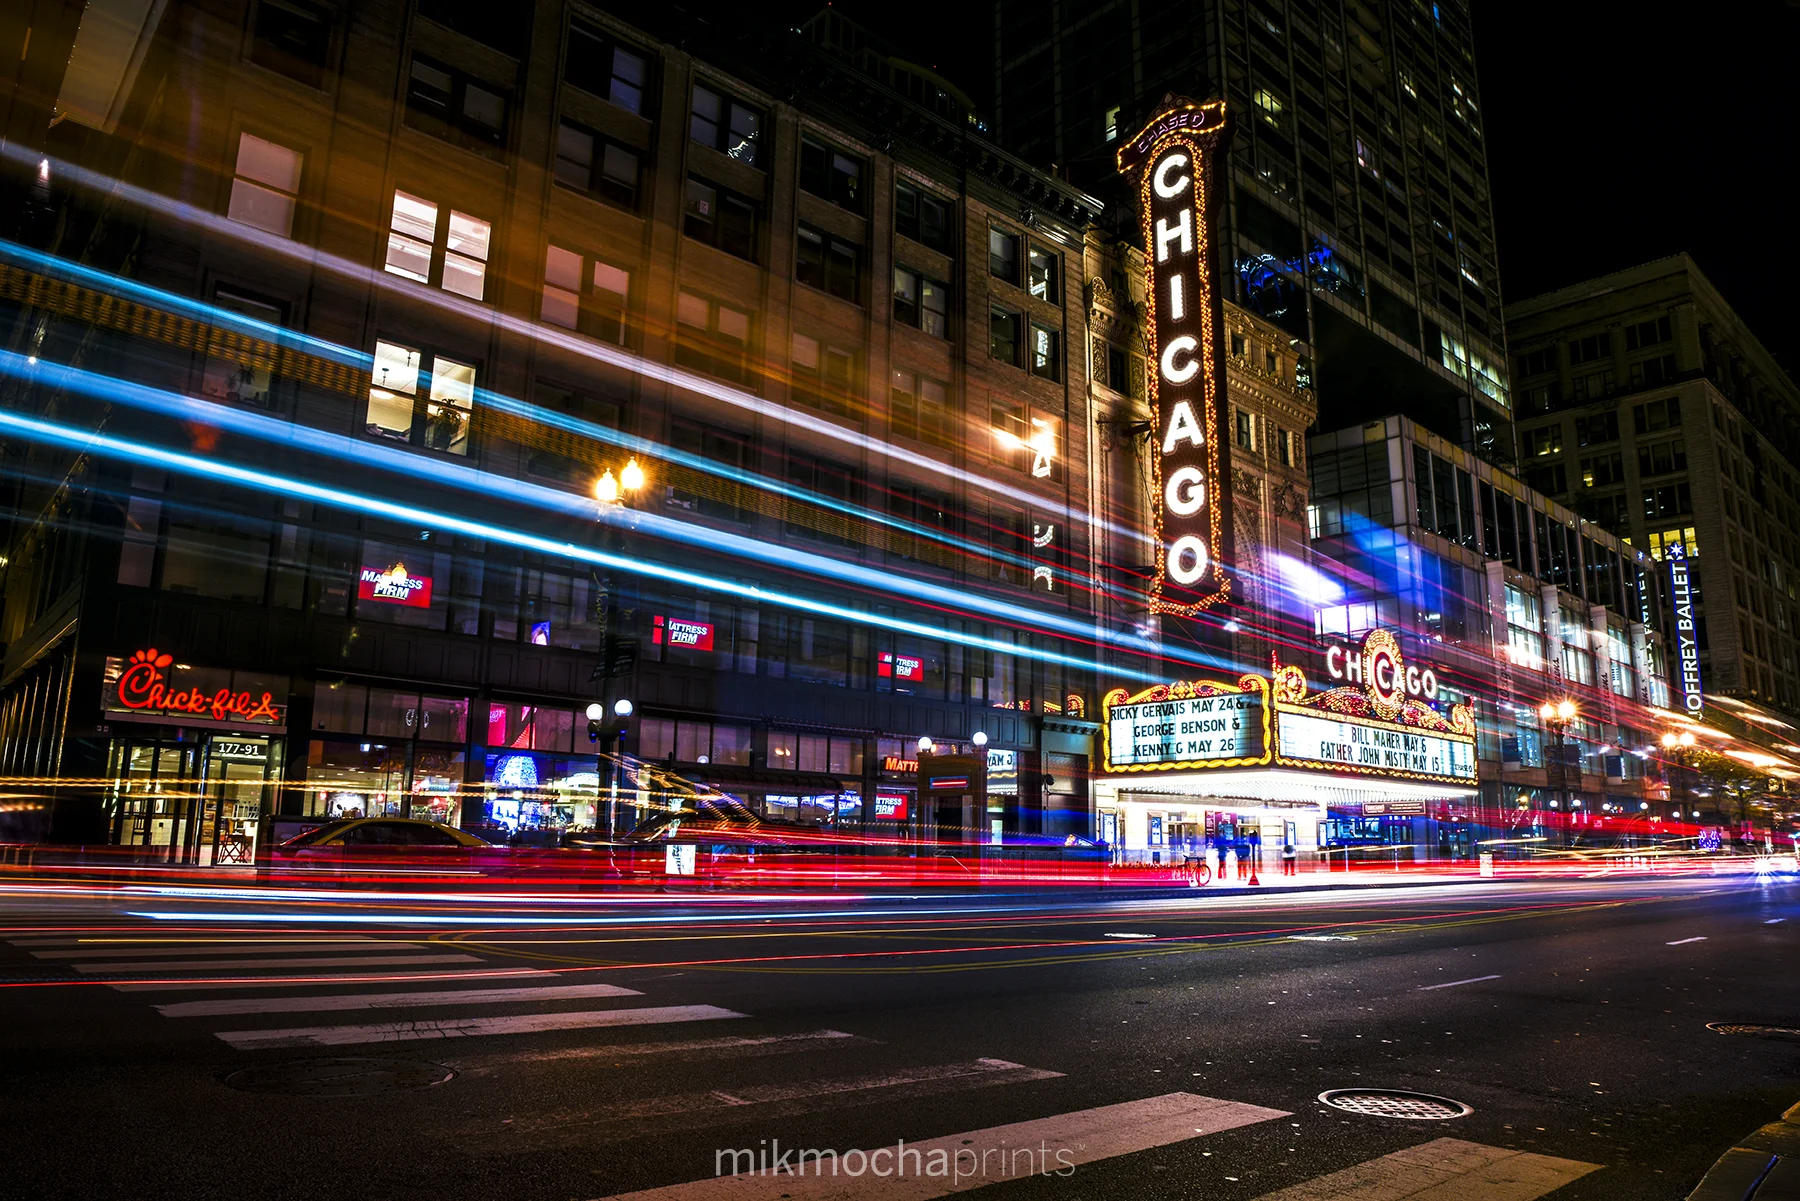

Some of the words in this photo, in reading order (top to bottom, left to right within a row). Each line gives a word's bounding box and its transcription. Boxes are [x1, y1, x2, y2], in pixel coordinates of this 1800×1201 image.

[1138, 112, 1189, 153] CHASE
[1154, 153, 1208, 584] CHICAGO
[1672, 563, 1693, 631] BALLET
[672, 631, 698, 643] FIRM
[896, 666, 912, 676] IRM
[1327, 645, 1438, 699] CHICAGO
[1680, 635, 1702, 720] JOFFREY
[118, 657, 279, 721] Chick-fil-A
[1111, 707, 1138, 721] RICKY
[1142, 702, 1185, 718] GERVAIS
[1191, 699, 1214, 714] MAY
[1134, 722, 1175, 737] GEORGE
[1181, 719, 1226, 734] BENSON
[1232, 718, 1241, 730] &
[1351, 726, 1370, 746] BILL
[1373, 730, 1401, 750] MAHER
[1404, 735, 1418, 752] MAY
[1421, 738, 1427, 753] 6
[219, 742, 259, 756] 177-91
[1134, 742, 1171, 757] KENNY
[1176, 742, 1183, 754] G
[1188, 740, 1212, 753] MAY
[1220, 738, 1234, 751] 26
[1321, 741, 1353, 761] FATHER
[1358, 745, 1380, 765] JOHN
[1384, 750, 1409, 769] MISTY
[1413, 753, 1428, 771] MAY
[1432, 756, 1439, 771] 15
